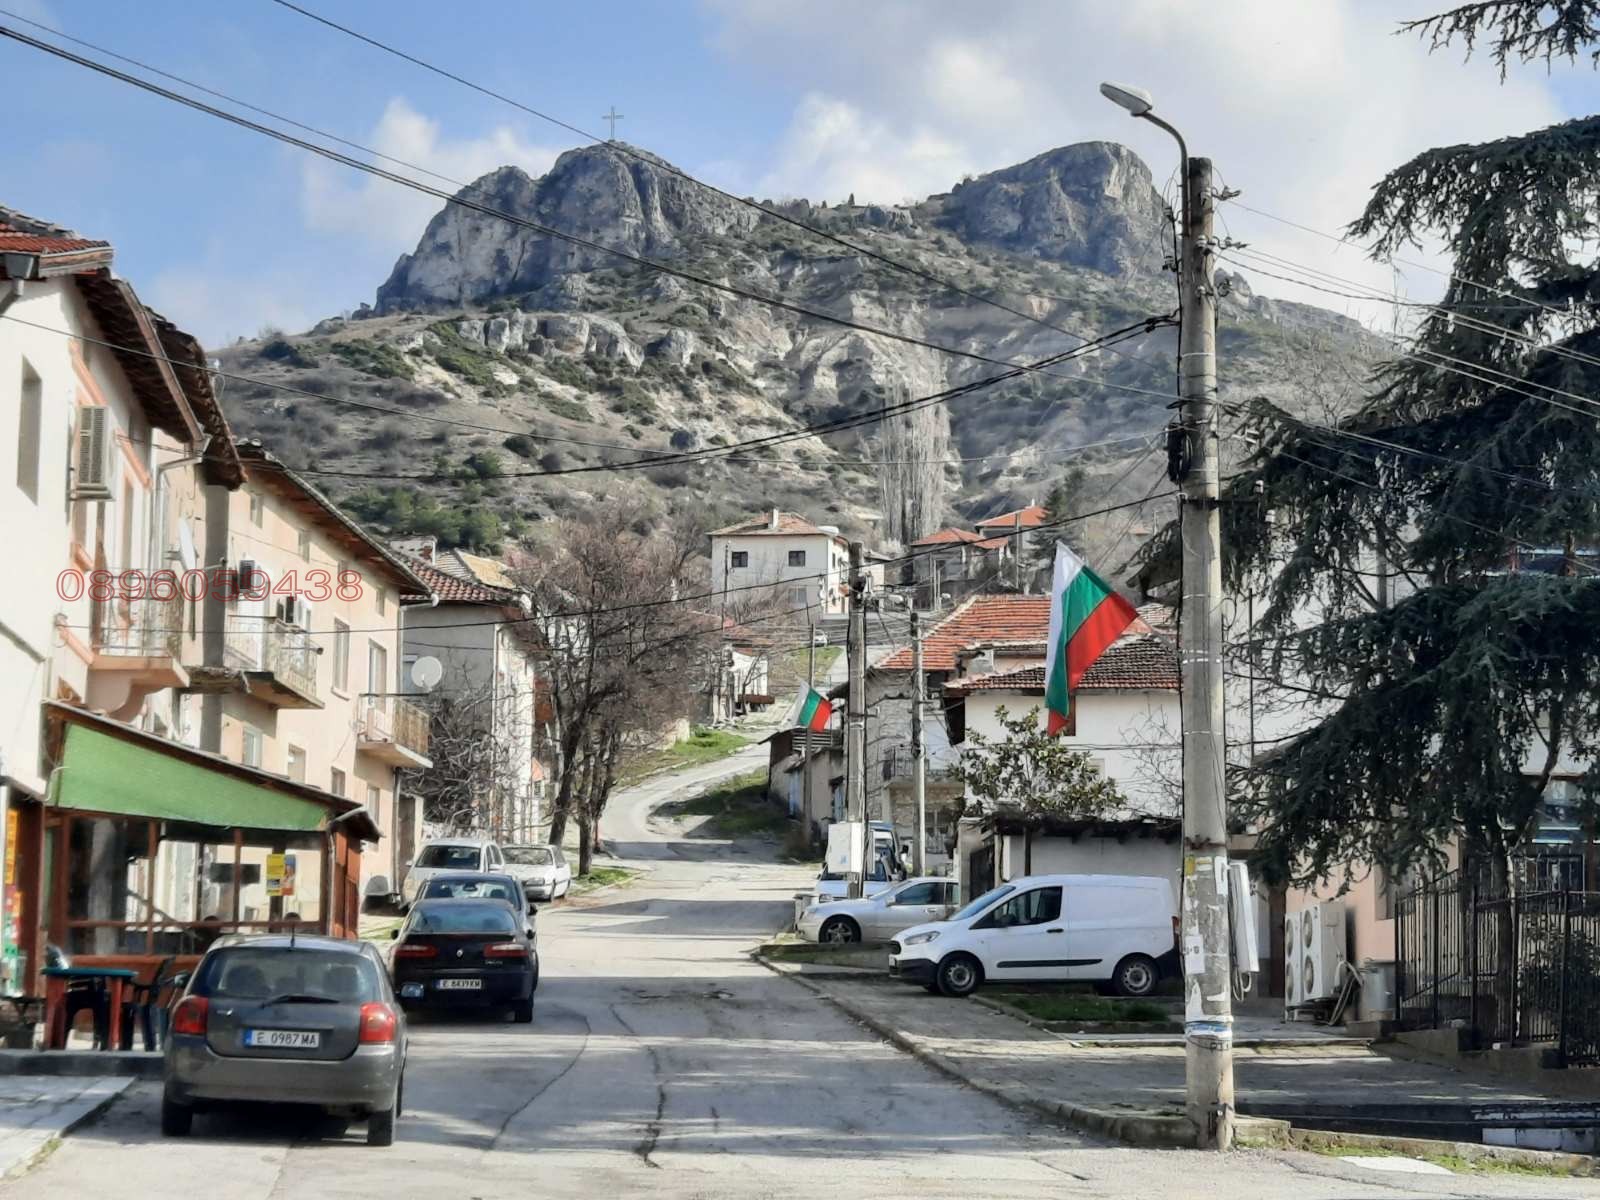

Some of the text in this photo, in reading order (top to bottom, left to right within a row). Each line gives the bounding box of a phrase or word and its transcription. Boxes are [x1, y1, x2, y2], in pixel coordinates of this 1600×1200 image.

[257, 1032, 317, 1046] E 0987 MA
